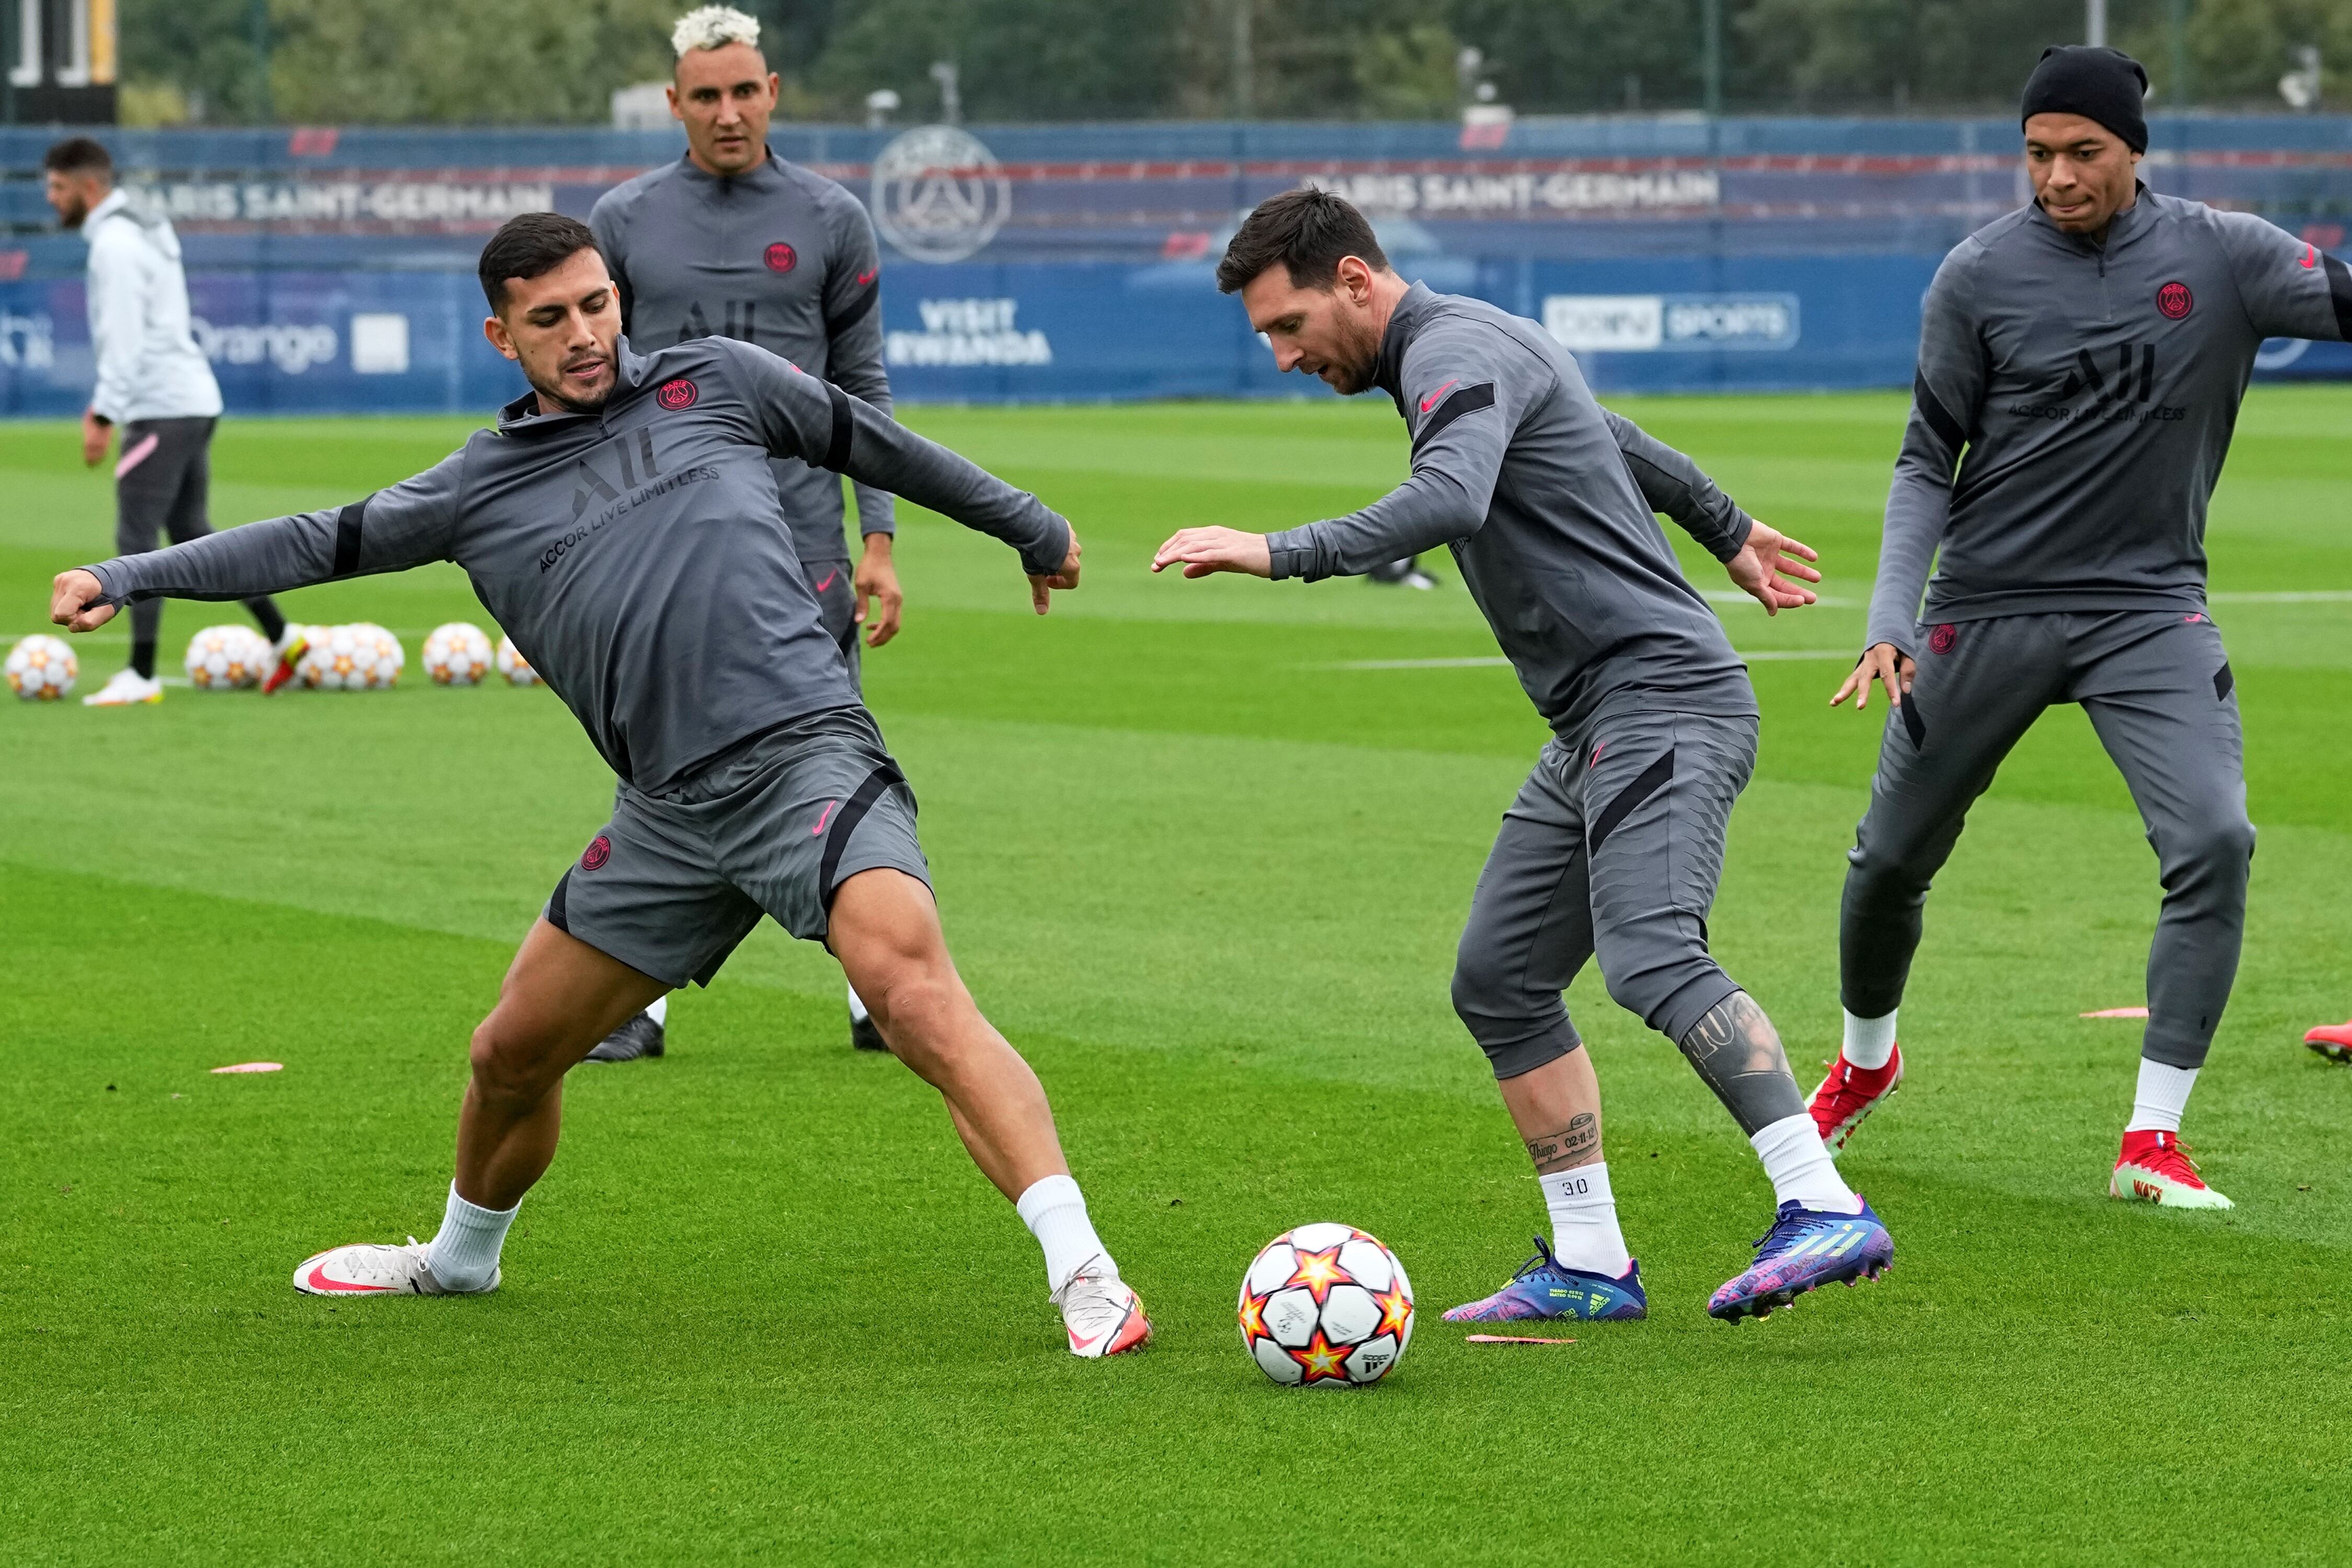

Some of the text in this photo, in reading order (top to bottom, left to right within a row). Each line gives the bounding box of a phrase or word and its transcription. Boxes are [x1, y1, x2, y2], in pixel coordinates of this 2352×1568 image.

[2164, 285, 2184, 294] PARIS
[919, 298, 1017, 331] VISIT
[886, 330, 1053, 364] RWANDA
[663, 381, 686, 391] PARIS
[2008, 403, 2070, 421] ACCOR
[539, 467, 720, 574] ACCOR LIVE LIMITLESS
[1529, 1143, 1558, 1160] Thiago
[1562, 1178, 1588, 1196] 30
[1589, 1297, 1610, 1316] adidas
